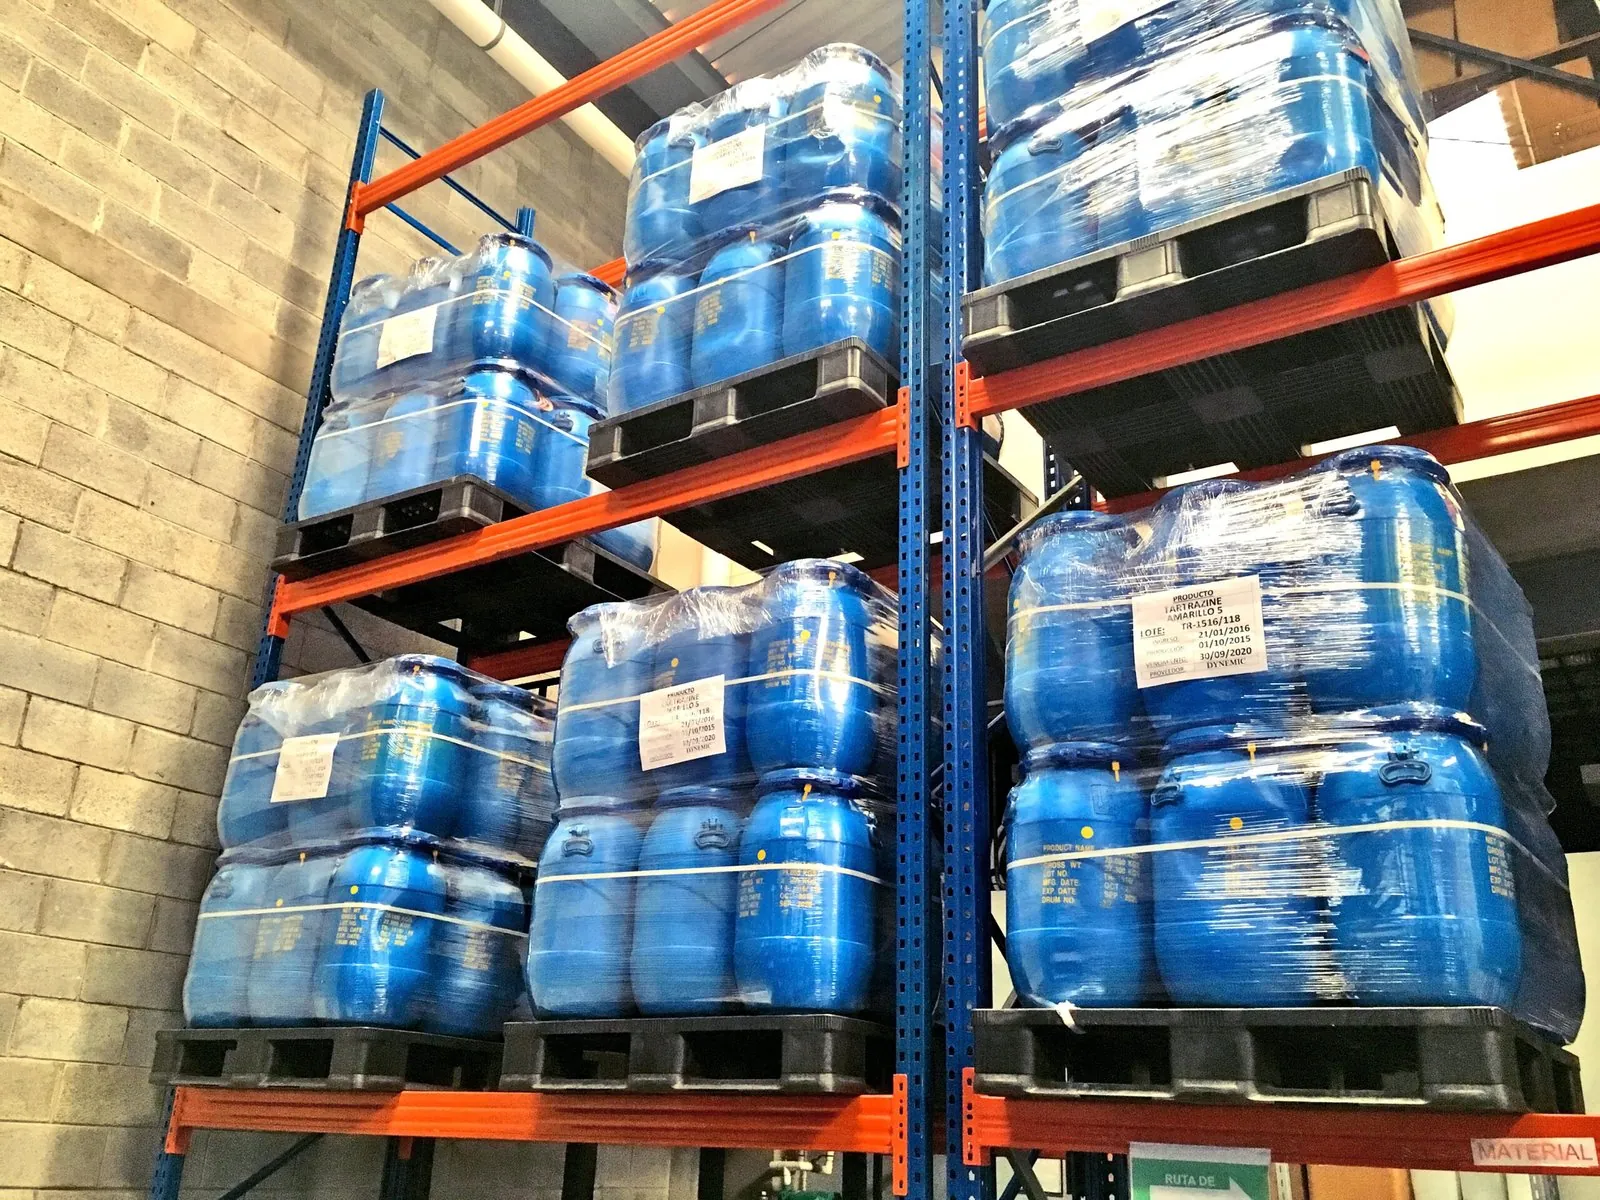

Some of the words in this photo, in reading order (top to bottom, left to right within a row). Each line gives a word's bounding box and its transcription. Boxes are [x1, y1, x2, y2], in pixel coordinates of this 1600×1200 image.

[1172, 590, 1214, 602] PRODUCTO
[1164, 597, 1222, 614] TARTRAZINE
[1167, 607, 1215, 621] AMARILLO
[1217, 606, 1223, 614] 5
[1181, 614, 1241, 630] TR-1516/118
[1198, 624, 1251, 638] 21/01/2016
[1198, 635, 1251, 649] 01/10/2015
[1200, 646, 1252, 660] 30/09/2020
[1206, 658, 1245, 669] DYNEMIC
[1043, 843, 1073, 851] PRODUCT
[1075, 844, 1096, 852] NAME
[1060, 878, 1080, 887] DATE
[1057, 887, 1077, 895] DATE
[1041, 895, 1061, 904] DRUM
[1477, 1143, 1594, 1161] MATERIAL
[1164, 1173, 1197, 1186] RUTA
[1198, 1175, 1216, 1187] DE
